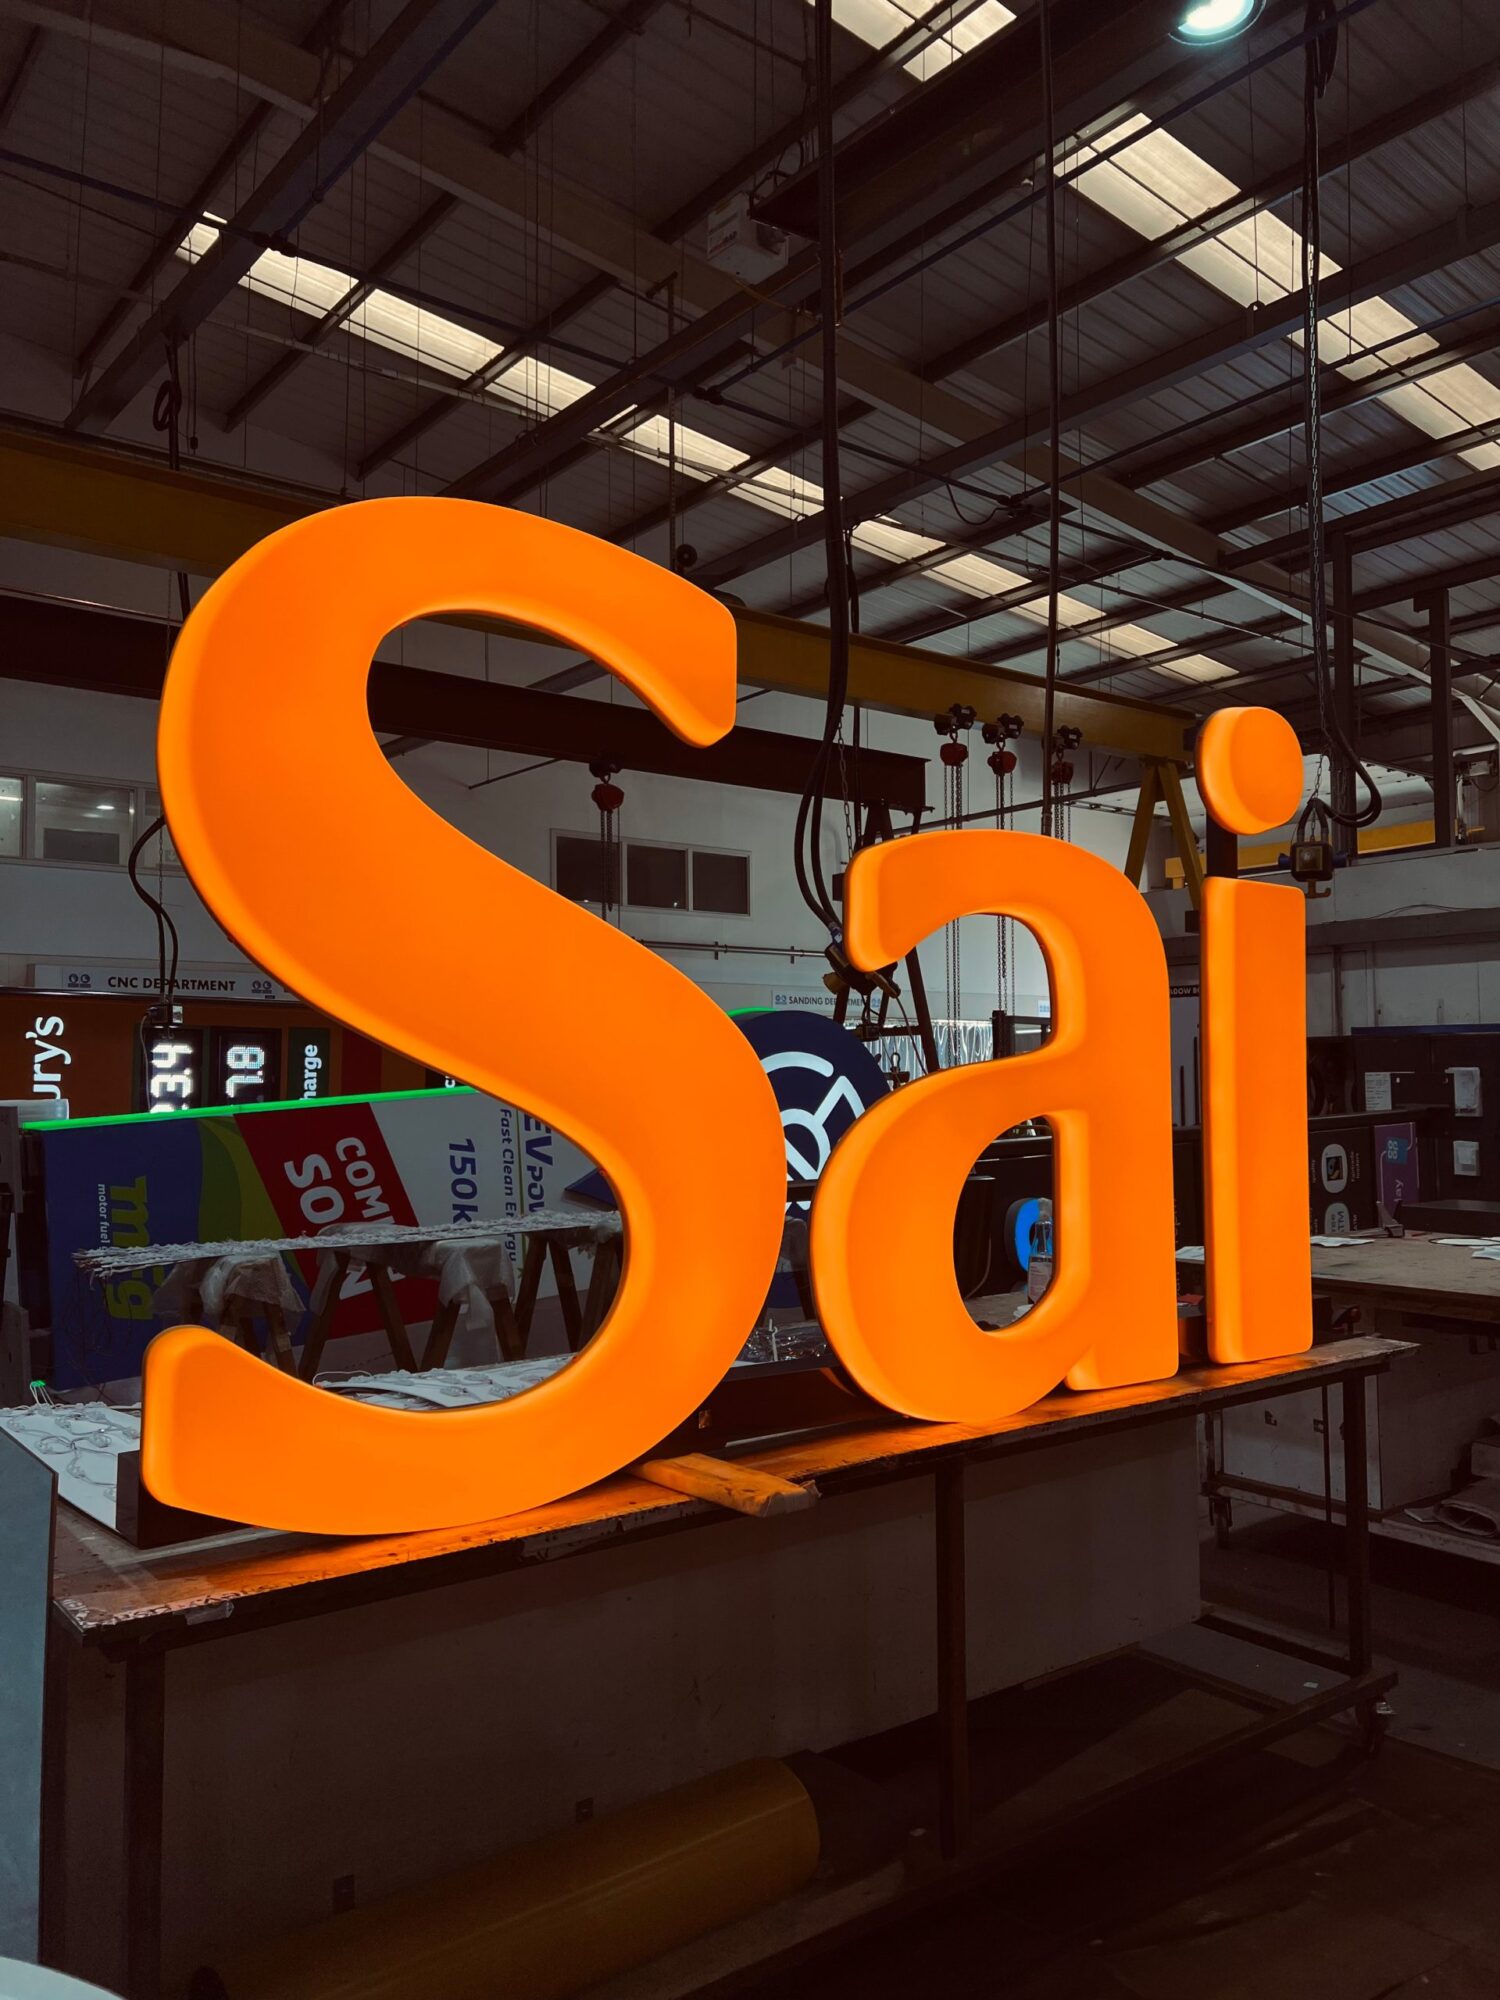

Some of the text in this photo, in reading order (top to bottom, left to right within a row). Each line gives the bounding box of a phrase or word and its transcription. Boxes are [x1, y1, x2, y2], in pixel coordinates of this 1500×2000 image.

[107, 976, 236, 992] CNC DEPARTMENT
[789, 996, 823, 1005] SANDING
[142, 496, 1313, 1537] Sai
[500, 1109, 513, 1144] Fast
[503, 1149, 515, 1196] Clean
[98, 1183, 109, 1219] motor
[99, 1221, 111, 1244] fuel
